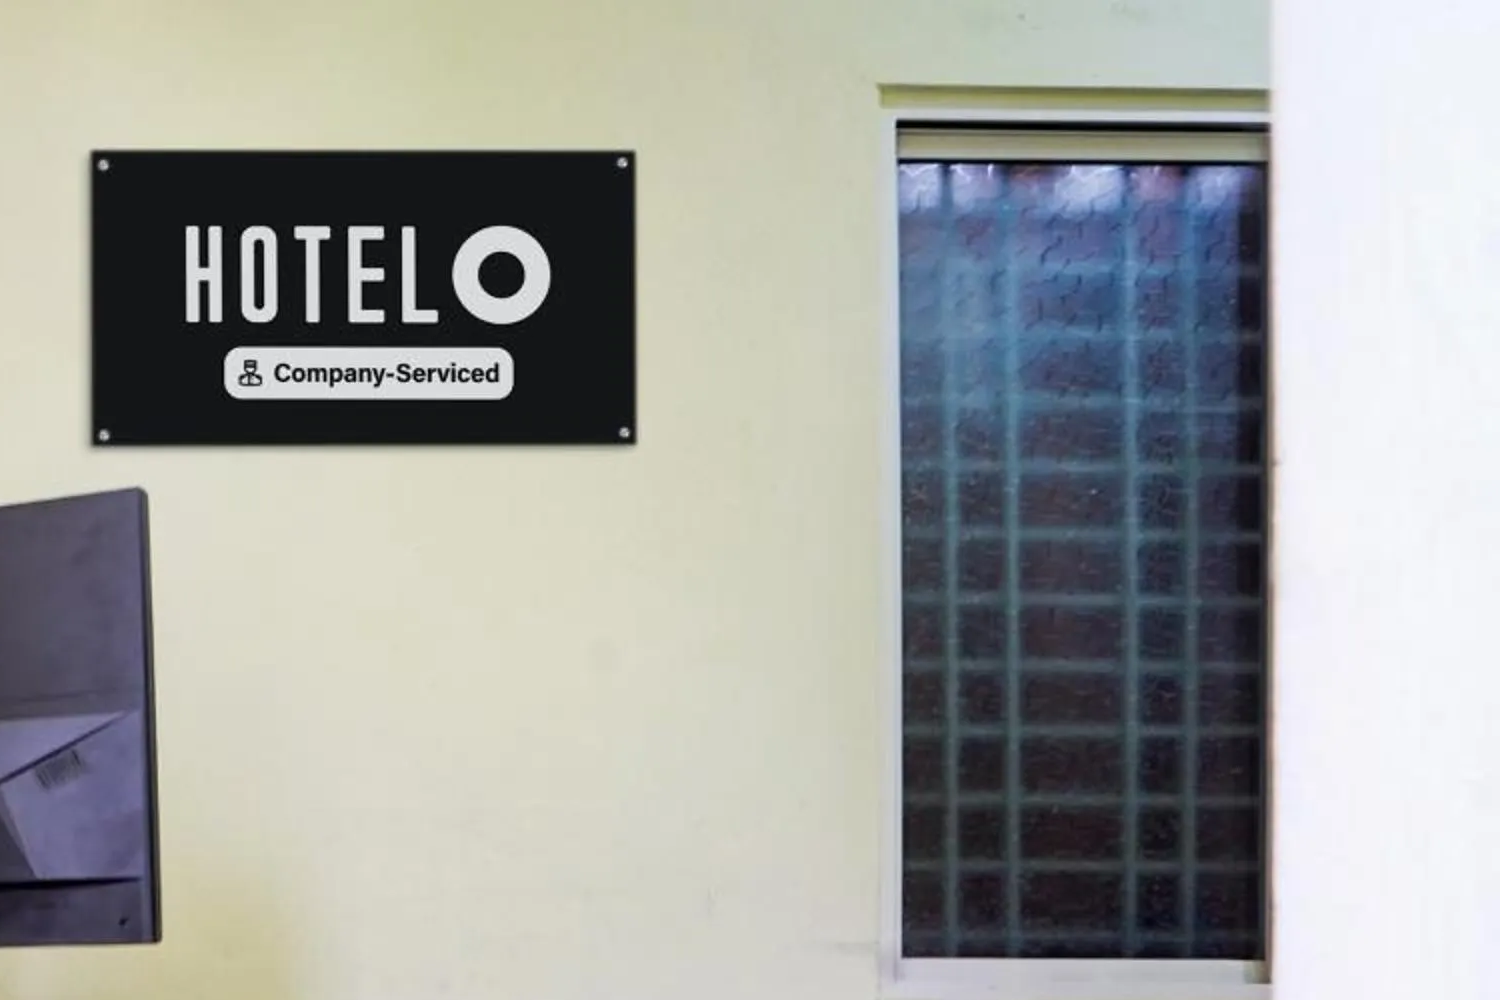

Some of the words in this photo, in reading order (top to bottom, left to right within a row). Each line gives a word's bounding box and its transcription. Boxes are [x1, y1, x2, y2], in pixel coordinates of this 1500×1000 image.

[185, 226, 439, 323] HOTEL
[452, 226, 551, 324] O
[273, 362, 501, 388] Company-Serviced
